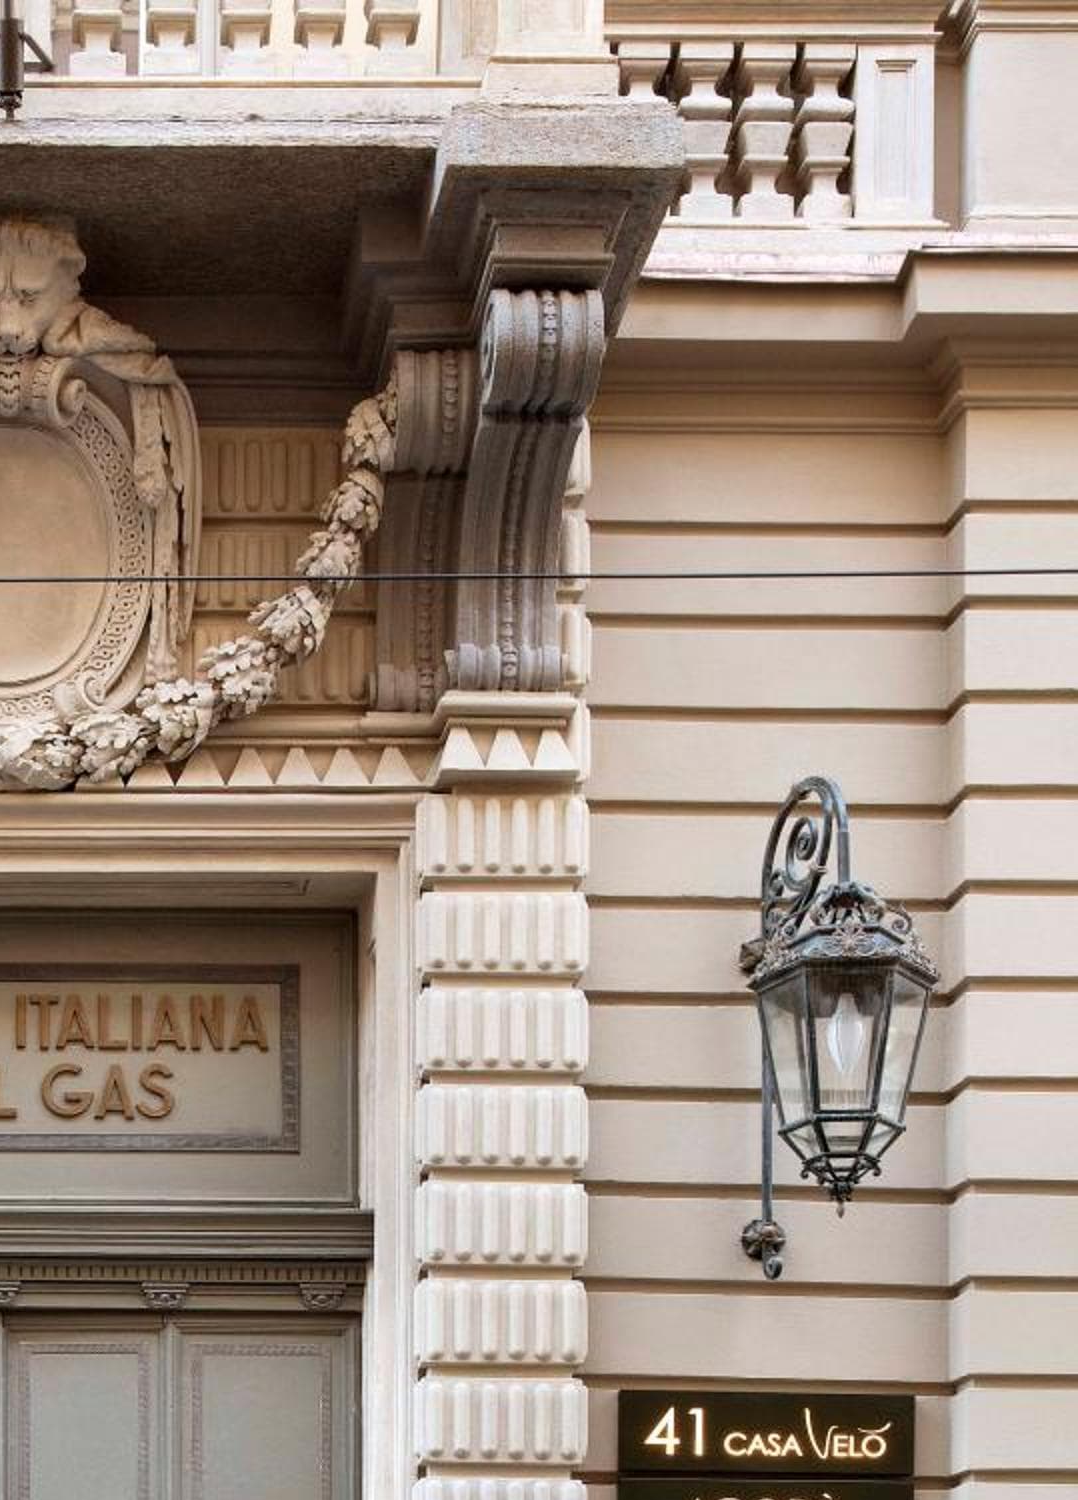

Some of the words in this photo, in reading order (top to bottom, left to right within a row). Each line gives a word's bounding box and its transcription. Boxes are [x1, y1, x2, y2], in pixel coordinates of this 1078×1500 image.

[15, 992, 269, 1051] ITALIANA
[40, 1062, 176, 1120] GAS
[643, 1406, 705, 1457] 41
[723, 1431, 803, 1457] CASA
